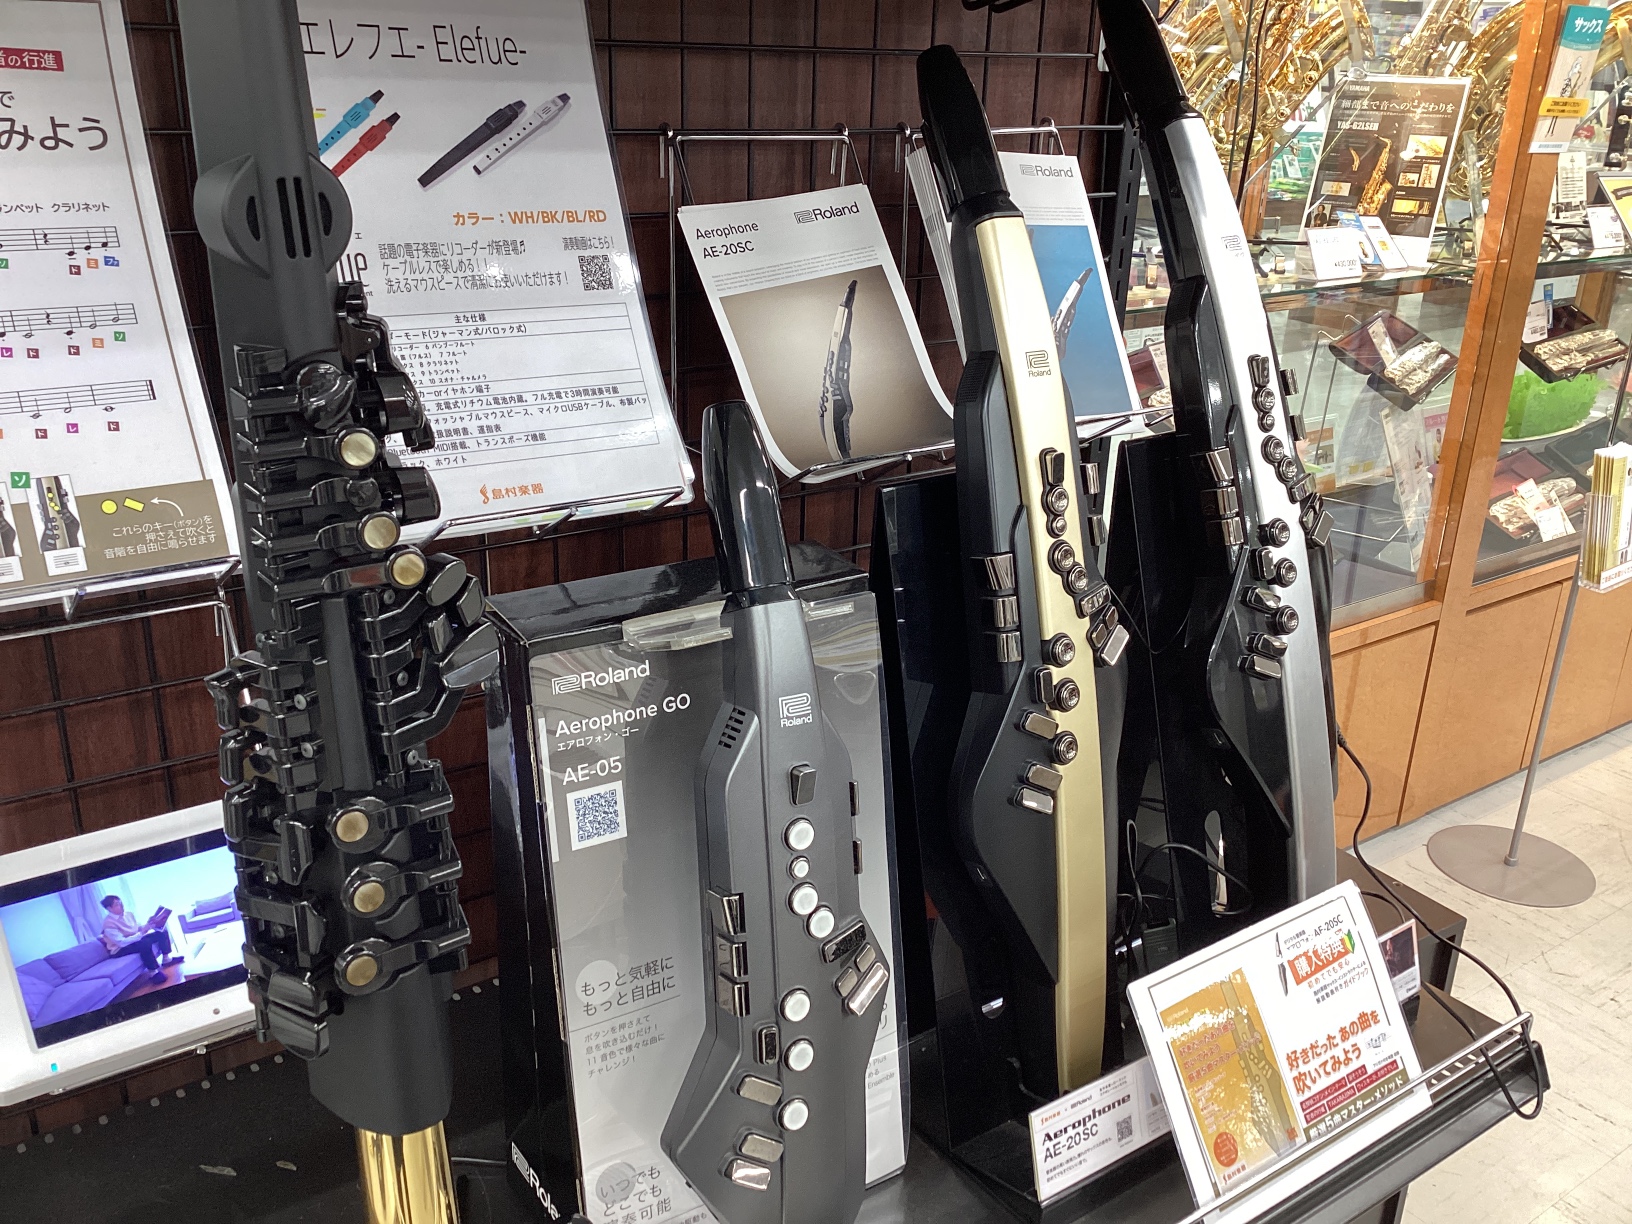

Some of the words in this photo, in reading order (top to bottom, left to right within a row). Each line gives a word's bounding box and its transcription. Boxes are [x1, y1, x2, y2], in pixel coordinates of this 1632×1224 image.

[1574, 17, 1604, 33] サックス
[0, 52, 57, 68] の行進
[0, 116, 109, 151] みよう
[1035, 166, 1074, 178] Roland
[51, 202, 110, 213] クラリネット
[814, 201, 860, 221] Roland
[695, 221, 759, 240] Aerophone
[702, 240, 755, 259] AE-20SC
[454, 312, 487, 325] 主な仕様
[1028, 368, 1051, 378] Roland
[434, 424, 502, 439] 扱説明書、運指表
[14, 474, 27, 487] ソ
[492, 482, 544, 501] 島村楽器
[145, 526, 216, 543] 押さえて吹くと
[581, 660, 650, 690] Roland
[555, 702, 658, 738] Aerophone
[662, 693, 691, 714] GO
[780, 714, 813, 729] Roland
[557, 727, 640, 752] エアロフォン・ゴー
[562, 756, 622, 786] AE-05
[581, 956, 674, 997] もっと気軽に
[583, 975, 676, 1017] もっと自由に
[584, 1014, 651, 1043] ボタンを押さえて
[1286, 1032, 1339, 1071] 好きだった
[1339, 1010, 1380, 1043] あの曲を
[1292, 1043, 1361, 1095] 吹いてみよう
[1042, 1094, 1131, 1146] Aerophone
[1044, 1123, 1099, 1163] AE-20SC
[600, 1165, 661, 1198] いつでも
[603, 1184, 662, 1217] どこでも
